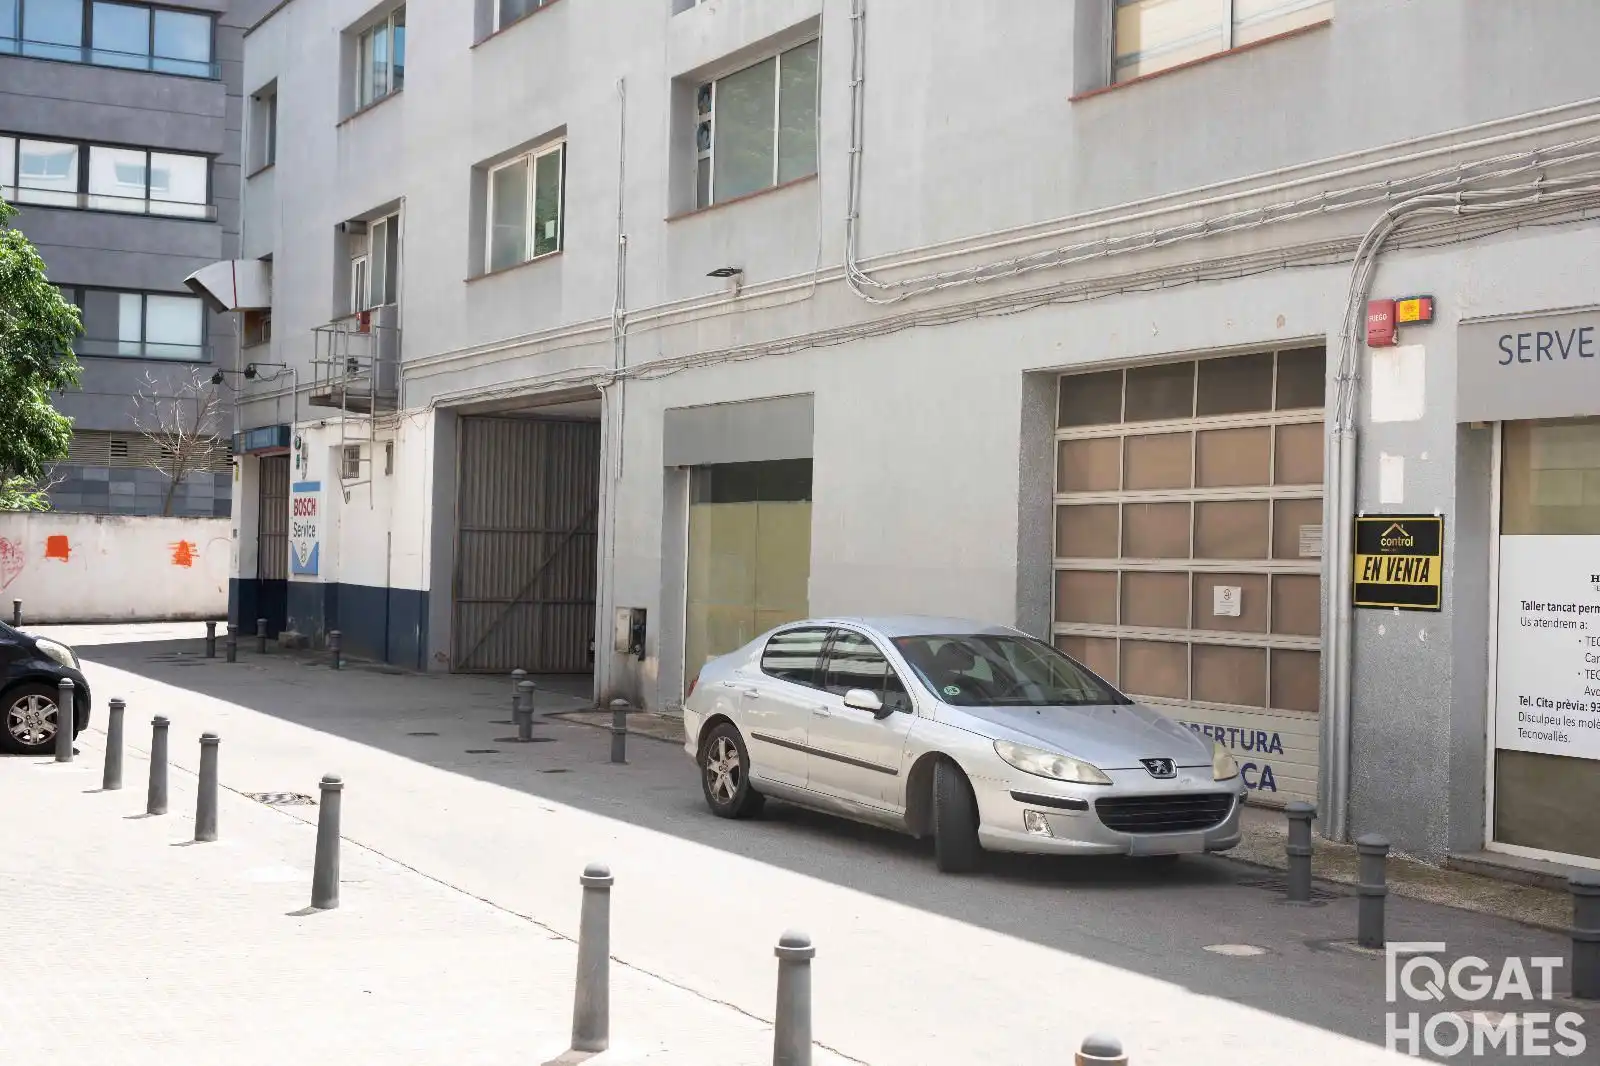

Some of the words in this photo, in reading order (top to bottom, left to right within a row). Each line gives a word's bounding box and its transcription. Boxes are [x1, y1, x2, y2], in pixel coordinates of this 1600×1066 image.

[1498, 326, 1595, 366] SERVE
[293, 497, 316, 517] BOSCH
[293, 520, 316, 538] Service
[1380, 535, 1414, 547] control
[1362, 556, 1383, 582] EN
[1386, 556, 1431, 583] VENTA
[1520, 600, 1545, 611] Taller
[1547, 602, 1576, 613] tancat
[1520, 616, 1532, 627] Us
[1533, 617, 1577, 629] atendrem
[1579, 621, 1588, 630] a:
[1518, 695, 1534, 707] Tel.
[1536, 697, 1554, 709] Cita
[1556, 699, 1588, 711] prèvia:
[1518, 711, 1561, 726] Disculpeu
[1563, 715, 1576, 727] les
